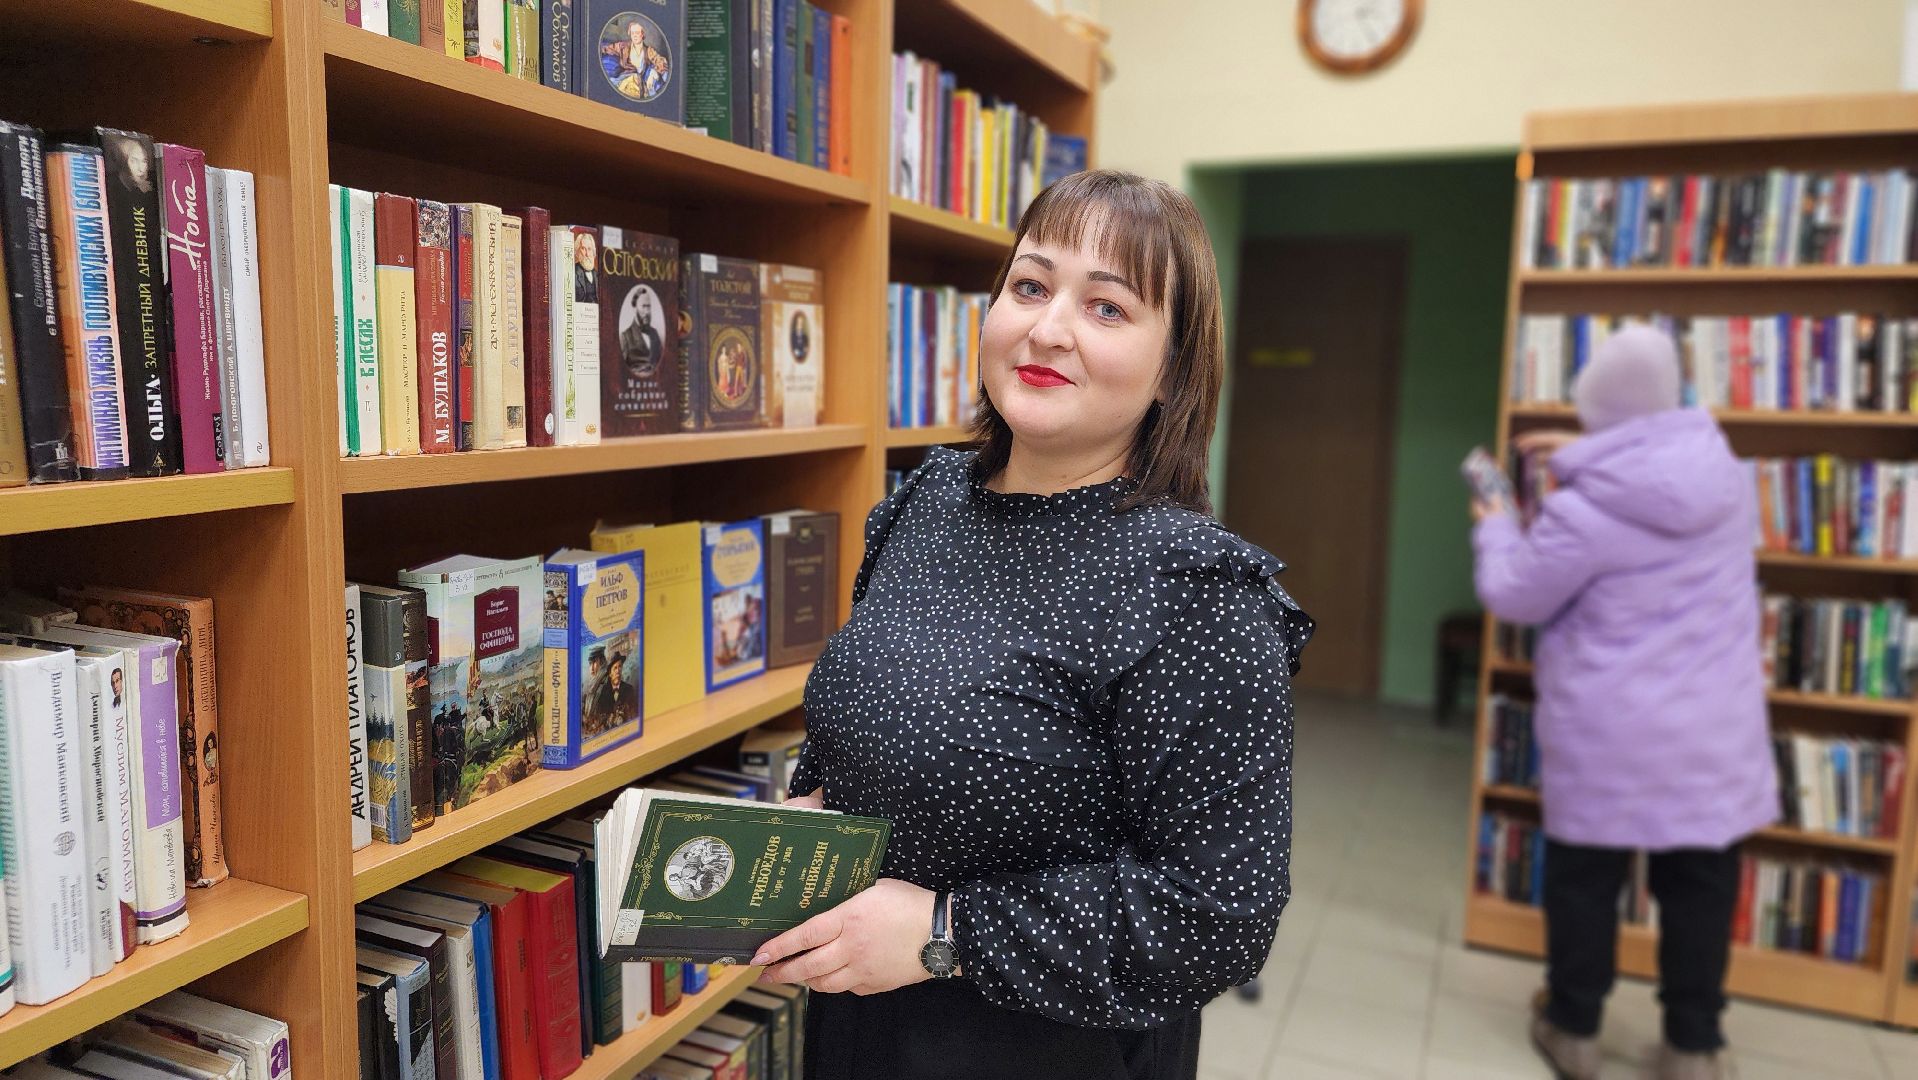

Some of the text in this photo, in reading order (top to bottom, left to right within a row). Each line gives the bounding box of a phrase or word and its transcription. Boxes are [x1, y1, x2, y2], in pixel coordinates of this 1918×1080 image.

[18, 134, 35, 200] Диалоги
[132, 206, 151, 278] ДНЕВНИК
[166, 160, 206, 271] Нота
[39, 233, 58, 326] Владимиром
[75, 214, 112, 331] ГОЛЛИВУДСКИХ
[504, 246, 519, 348] ПУШКИН
[139, 282, 158, 369] ЗАПРЕТНЫЙ
[223, 287, 234, 341] ШИРВИНДТ
[87, 335, 117, 389] ЖИЗНЬ
[228, 356, 239, 422] ПОЮРОВСКИЙ
[431, 331, 450, 444] М. БУЛГАКОВ
[595, 589, 628, 609] ПЕТРОВ
[600, 572, 624, 588] ИЛЬФ
[479, 633, 515, 651] ОФИЦЕРЫ
[481, 626, 513, 641] ГОСПОДА
[552, 661, 561, 688] ИЛЬФ
[51, 671, 71, 824] Владимир Маяковский
[90, 691, 100, 743] Дмитрий
[551, 707, 561, 745] ПЕТРОВ
[750, 835, 781, 907] ГРИБОЕДОВ
[769, 846, 794, 899] Горе от ума
[799, 841, 830, 909] ФОНВИЗИН
[818, 852, 841, 898] Недоросль
